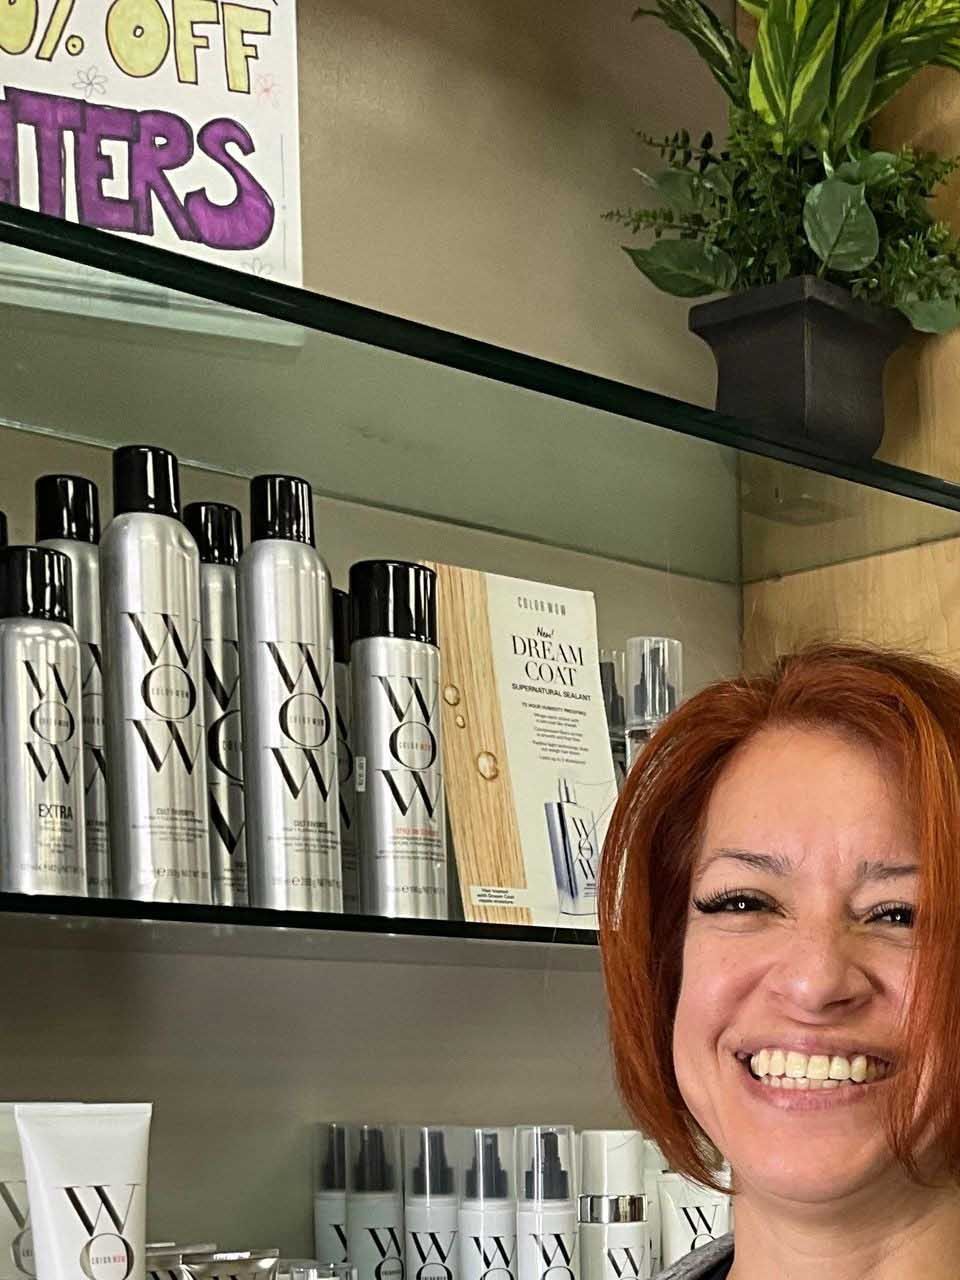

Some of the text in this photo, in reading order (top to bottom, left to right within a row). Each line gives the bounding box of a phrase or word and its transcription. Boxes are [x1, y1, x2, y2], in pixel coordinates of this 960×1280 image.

[105, 0, 272, 94] OFF
[0, 86, 275, 251] TERS
[512, 635, 584, 667] DREAM
[525, 661, 577, 687] COAT
[512, 683, 592, 702] SUPERNATURAL SEALANT
[38, 804, 74, 820] EXTRA
